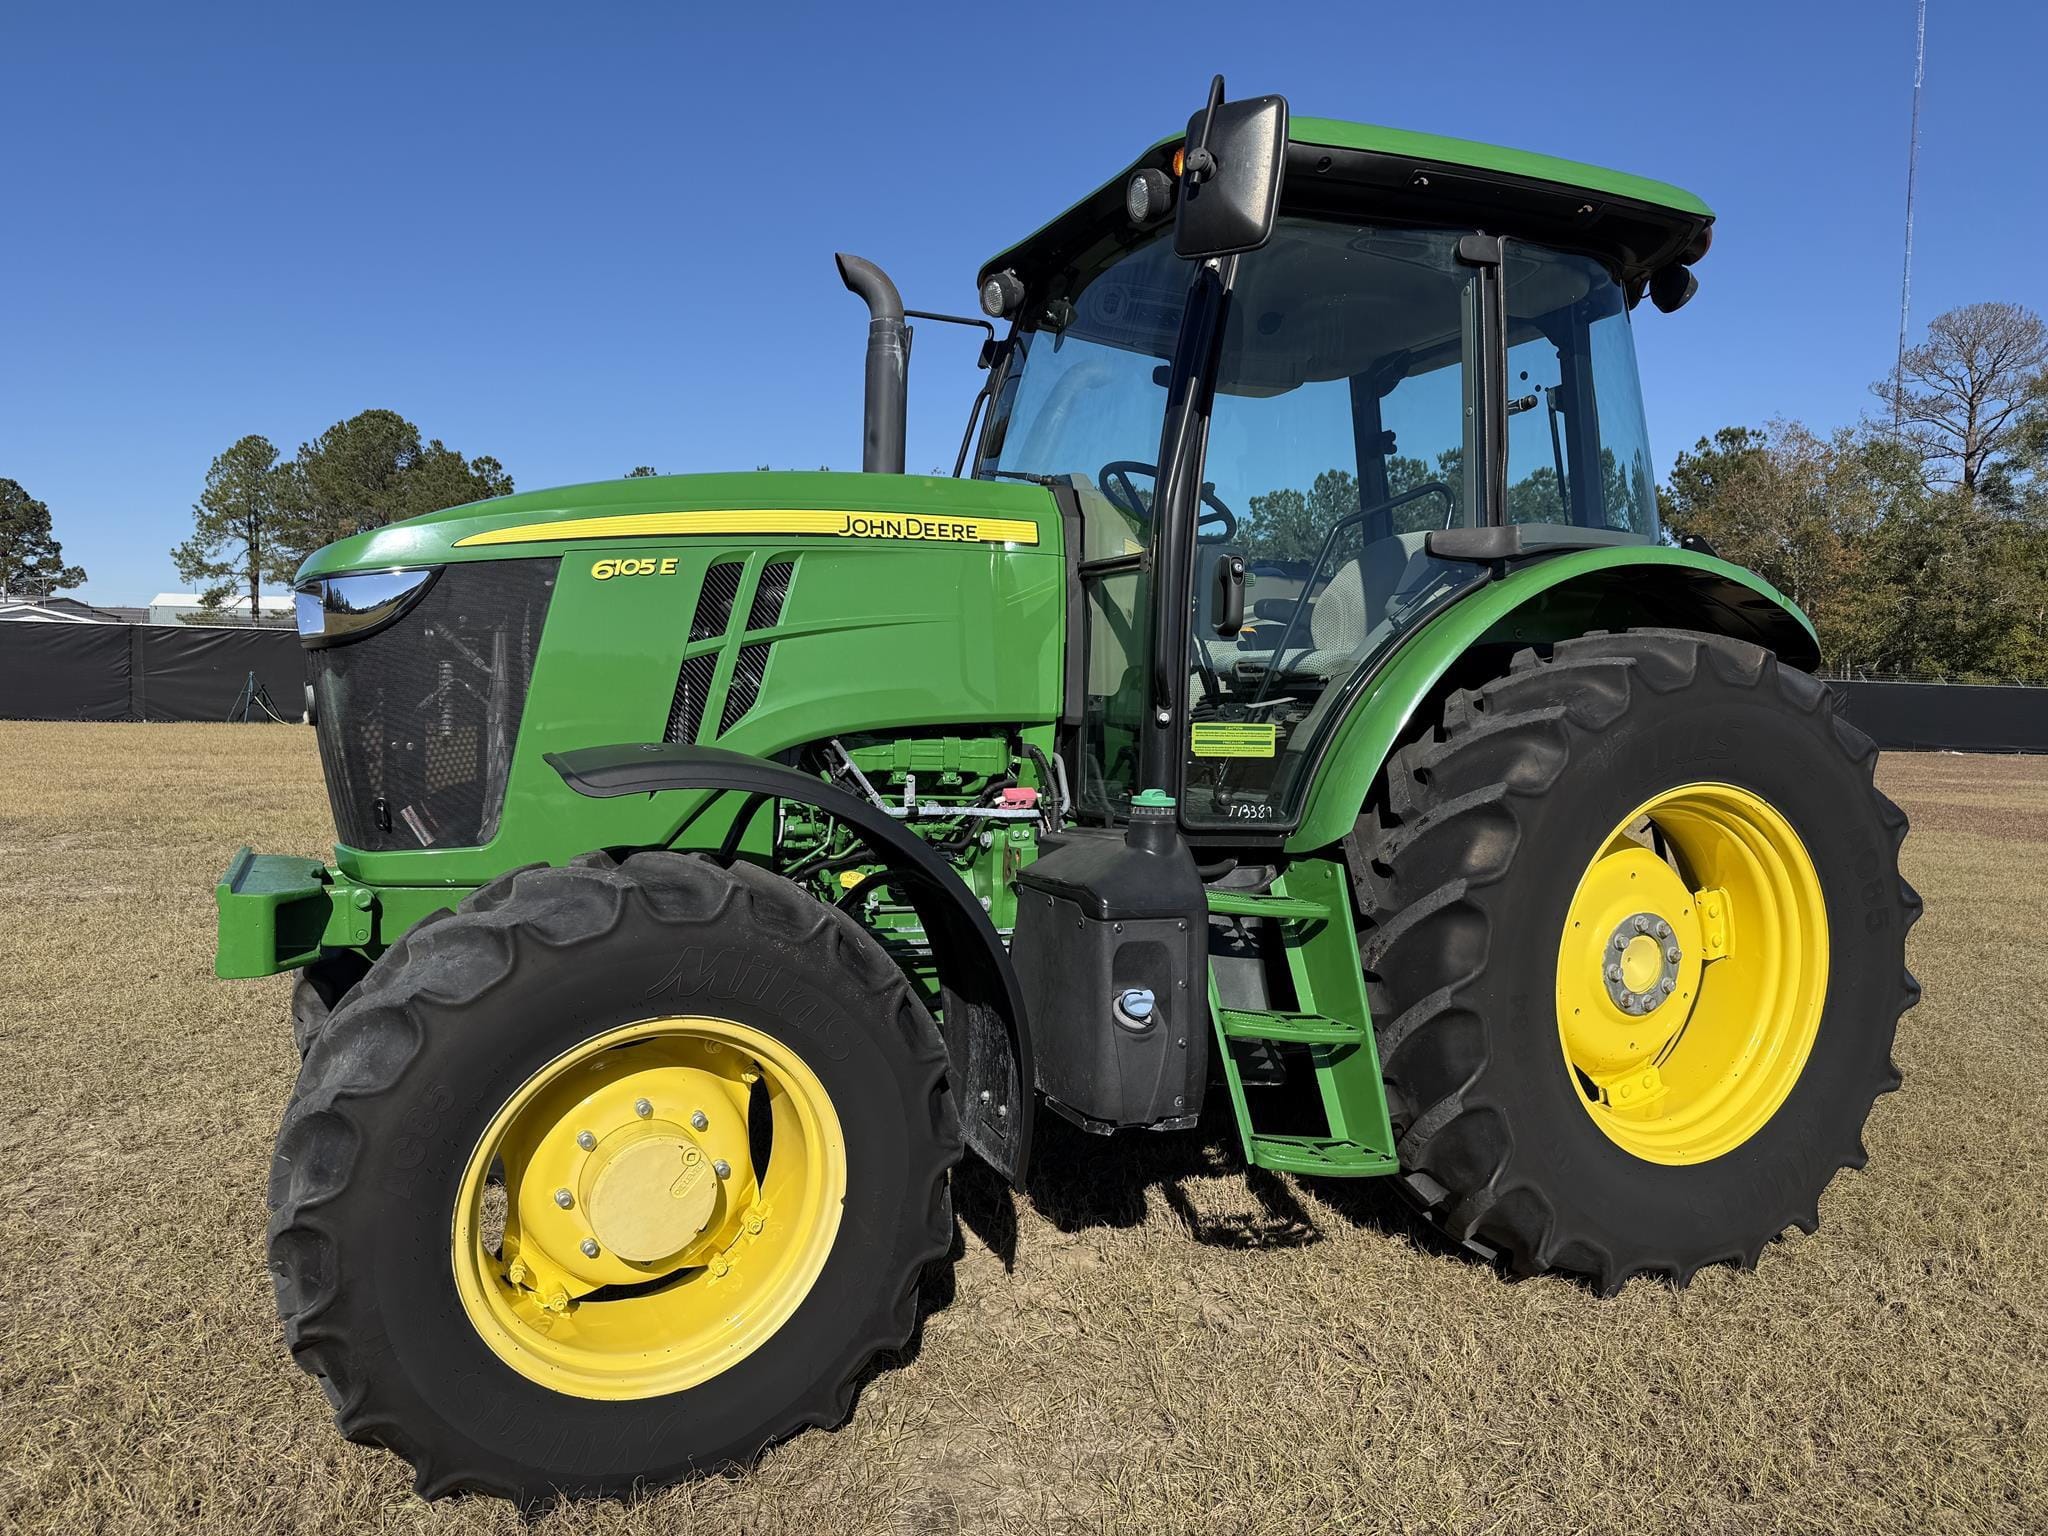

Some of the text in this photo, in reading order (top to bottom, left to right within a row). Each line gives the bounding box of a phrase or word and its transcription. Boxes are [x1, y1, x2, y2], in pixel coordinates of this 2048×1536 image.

[839, 515, 979, 539] JOHN DEERE
[591, 558, 679, 581] 6105 E
